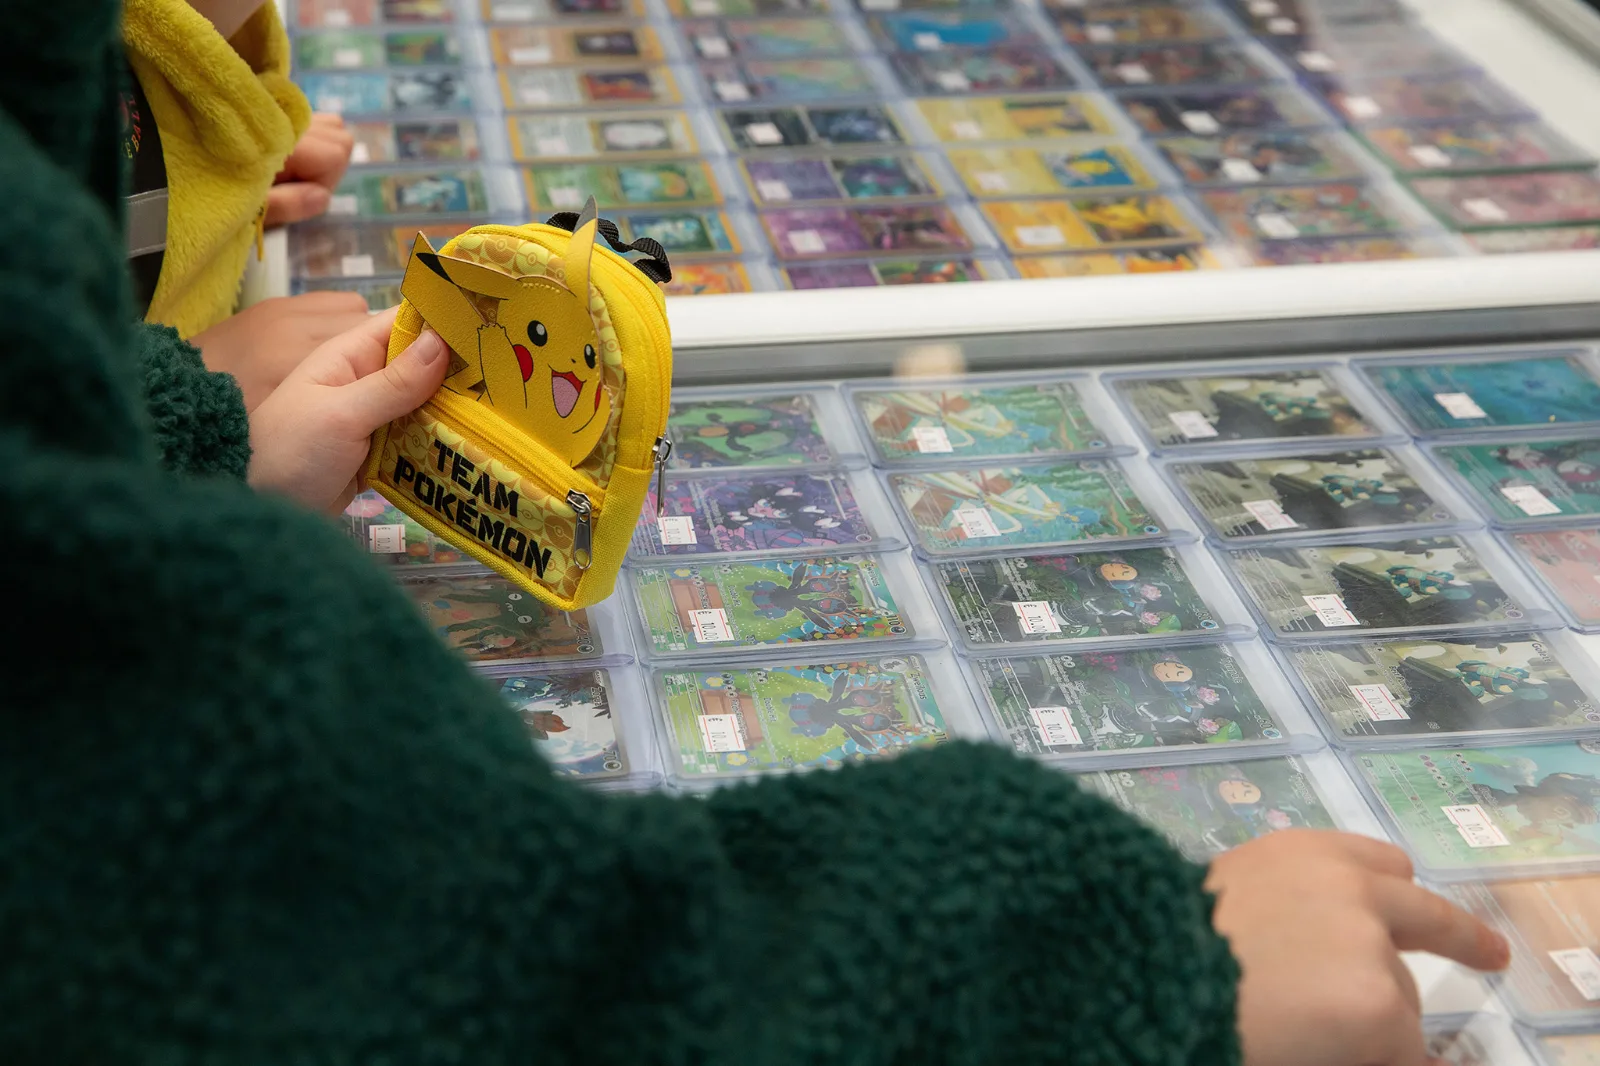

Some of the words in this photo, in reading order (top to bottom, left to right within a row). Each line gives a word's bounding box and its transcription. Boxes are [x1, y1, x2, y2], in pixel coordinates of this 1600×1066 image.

[433, 438, 520, 518] TEAM
[392, 455, 553, 578] POKÉMON
[699, 622, 720, 641] 10.00
[1026, 615, 1049, 633] 10.00
[908, 672, 930, 700] Zweilous
[1364, 695, 1392, 716] 10.00
[1044, 723, 1069, 743] 10.00
[1462, 822, 1495, 846] 10.00
